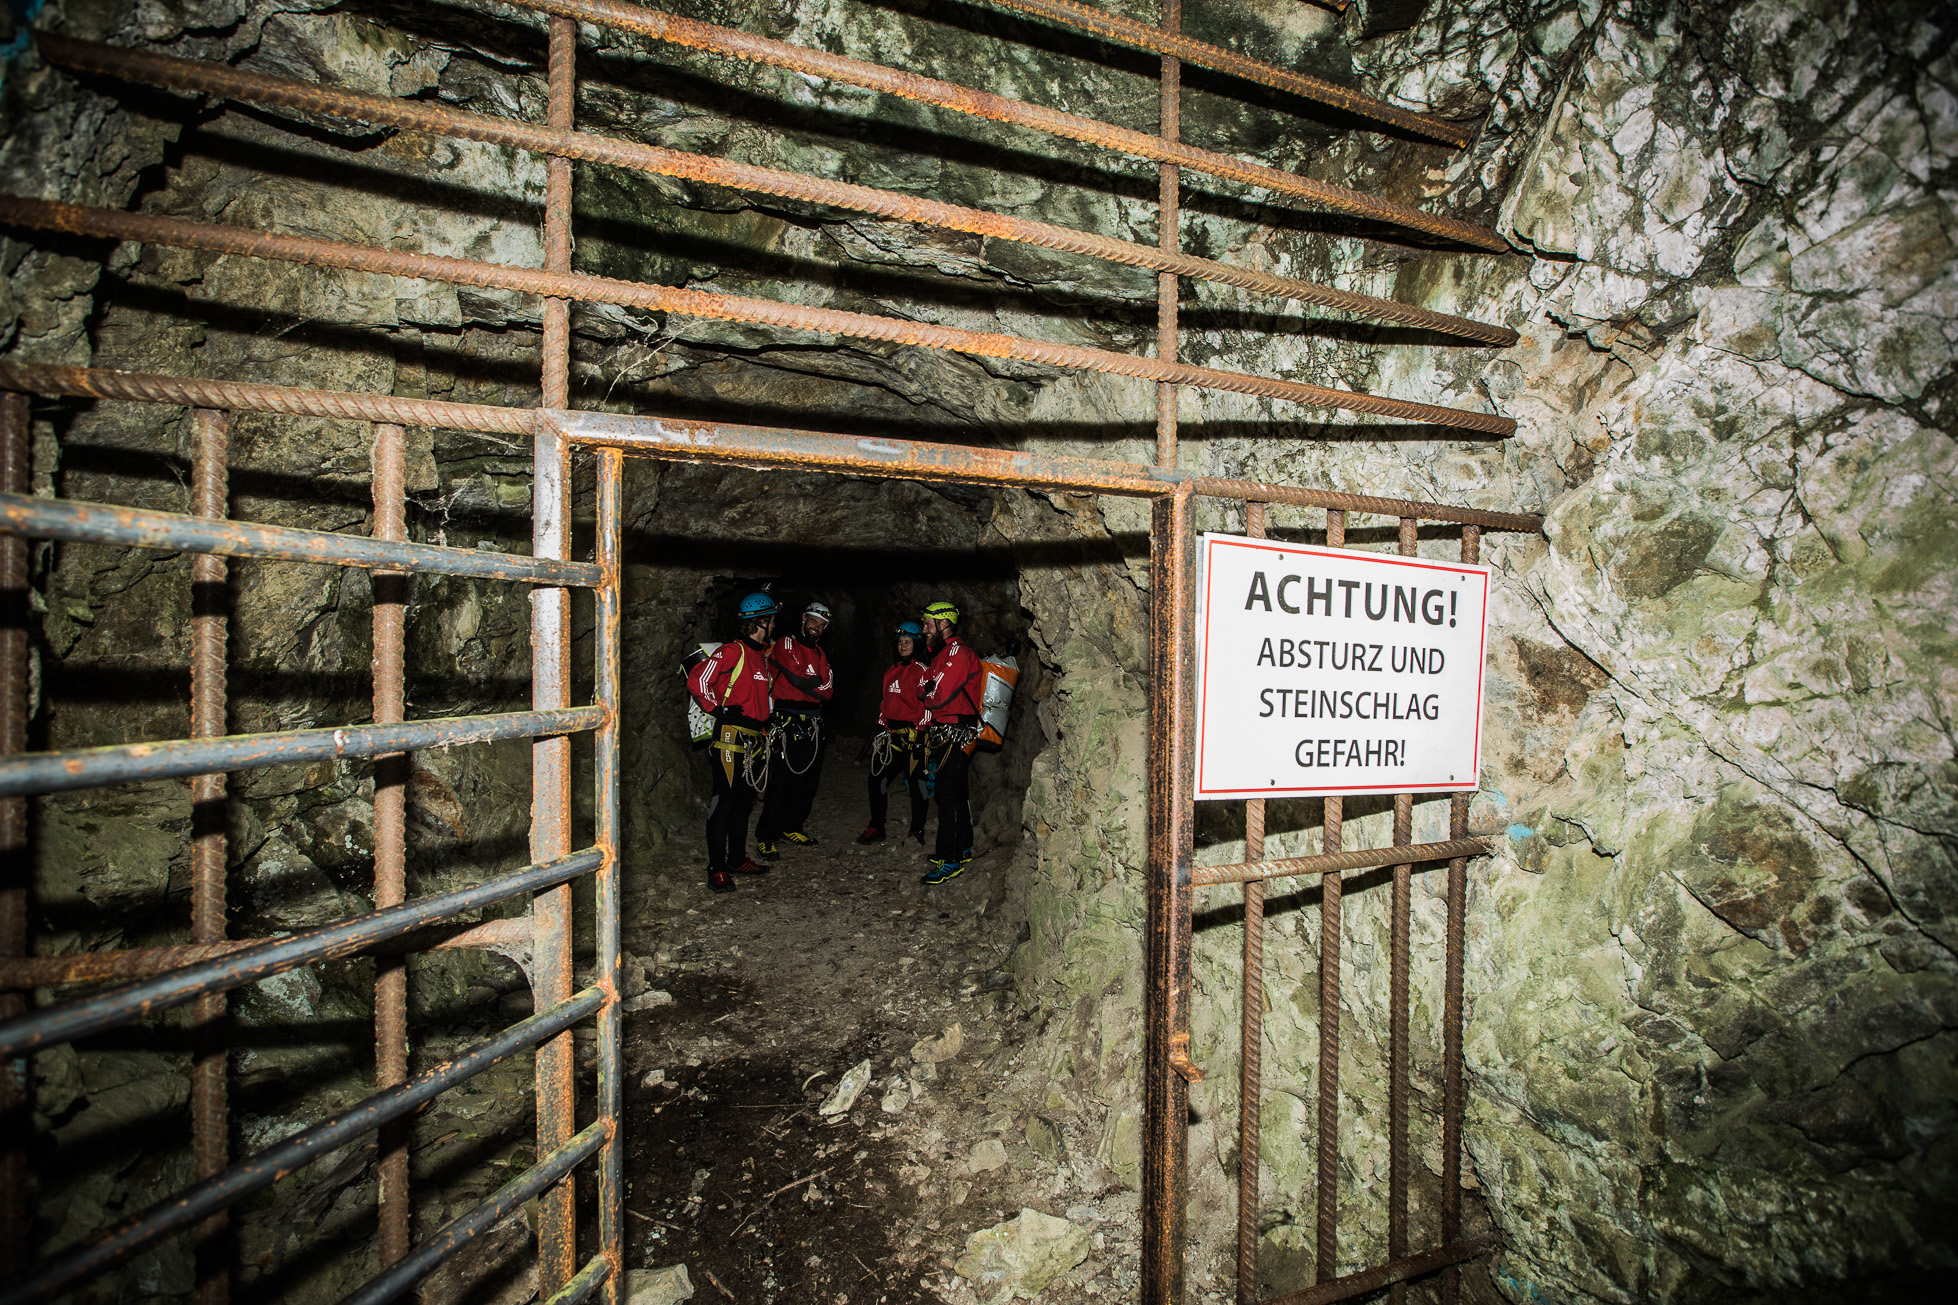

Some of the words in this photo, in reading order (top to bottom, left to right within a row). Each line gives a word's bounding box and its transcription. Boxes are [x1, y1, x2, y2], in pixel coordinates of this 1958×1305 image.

[1244, 570, 1458, 628] ACHTUNG!
[1257, 638, 1383, 671] ABSTURZ
[1392, 646, 1444, 674] UND
[1260, 688, 1438, 720] STEINSCHLAG
[1295, 740, 1405, 767] GEFAHR!
